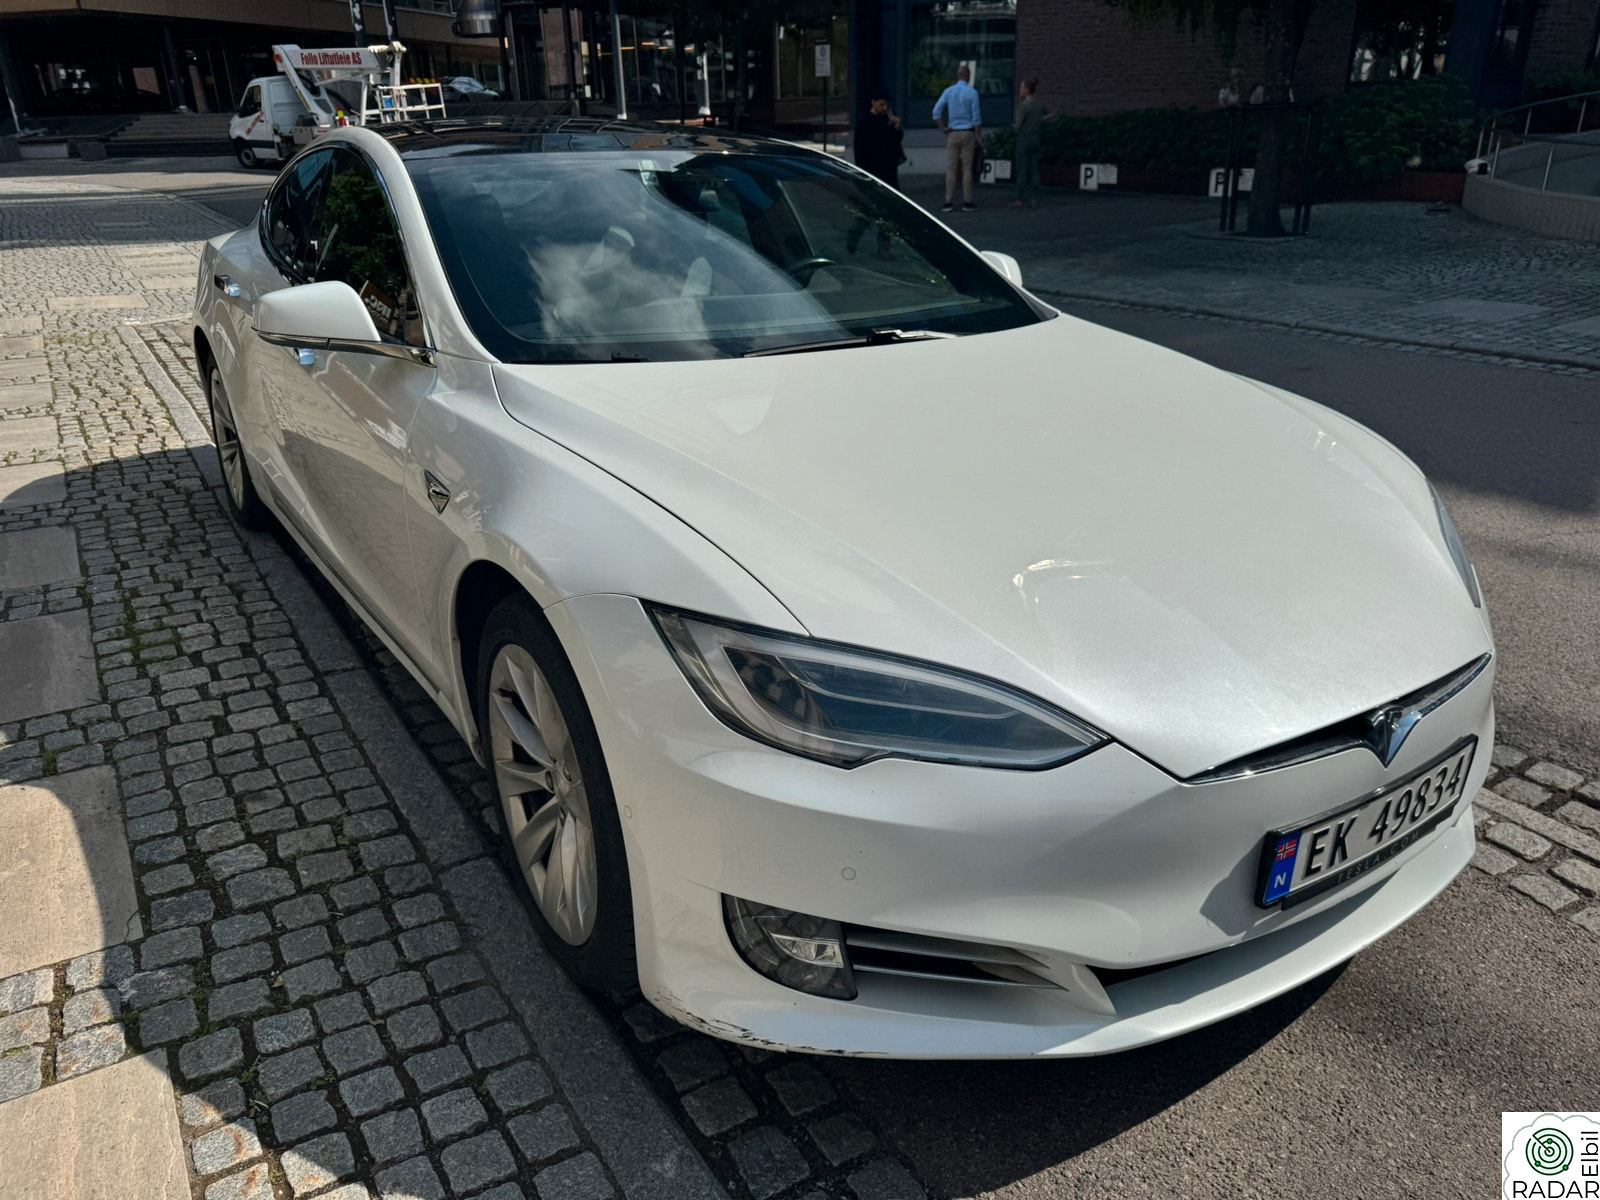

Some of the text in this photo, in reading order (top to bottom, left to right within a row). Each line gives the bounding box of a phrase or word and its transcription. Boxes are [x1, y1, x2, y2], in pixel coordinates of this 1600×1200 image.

[301, 51, 362, 65] Follo Liftutleie AS
[983, 162, 992, 180] P
[1084, 167, 1094, 186] P
[1303, 752, 1465, 880] EK 49834
[1337, 829, 1421, 885] TESLA.COM
[1273, 872, 1286, 888] N
